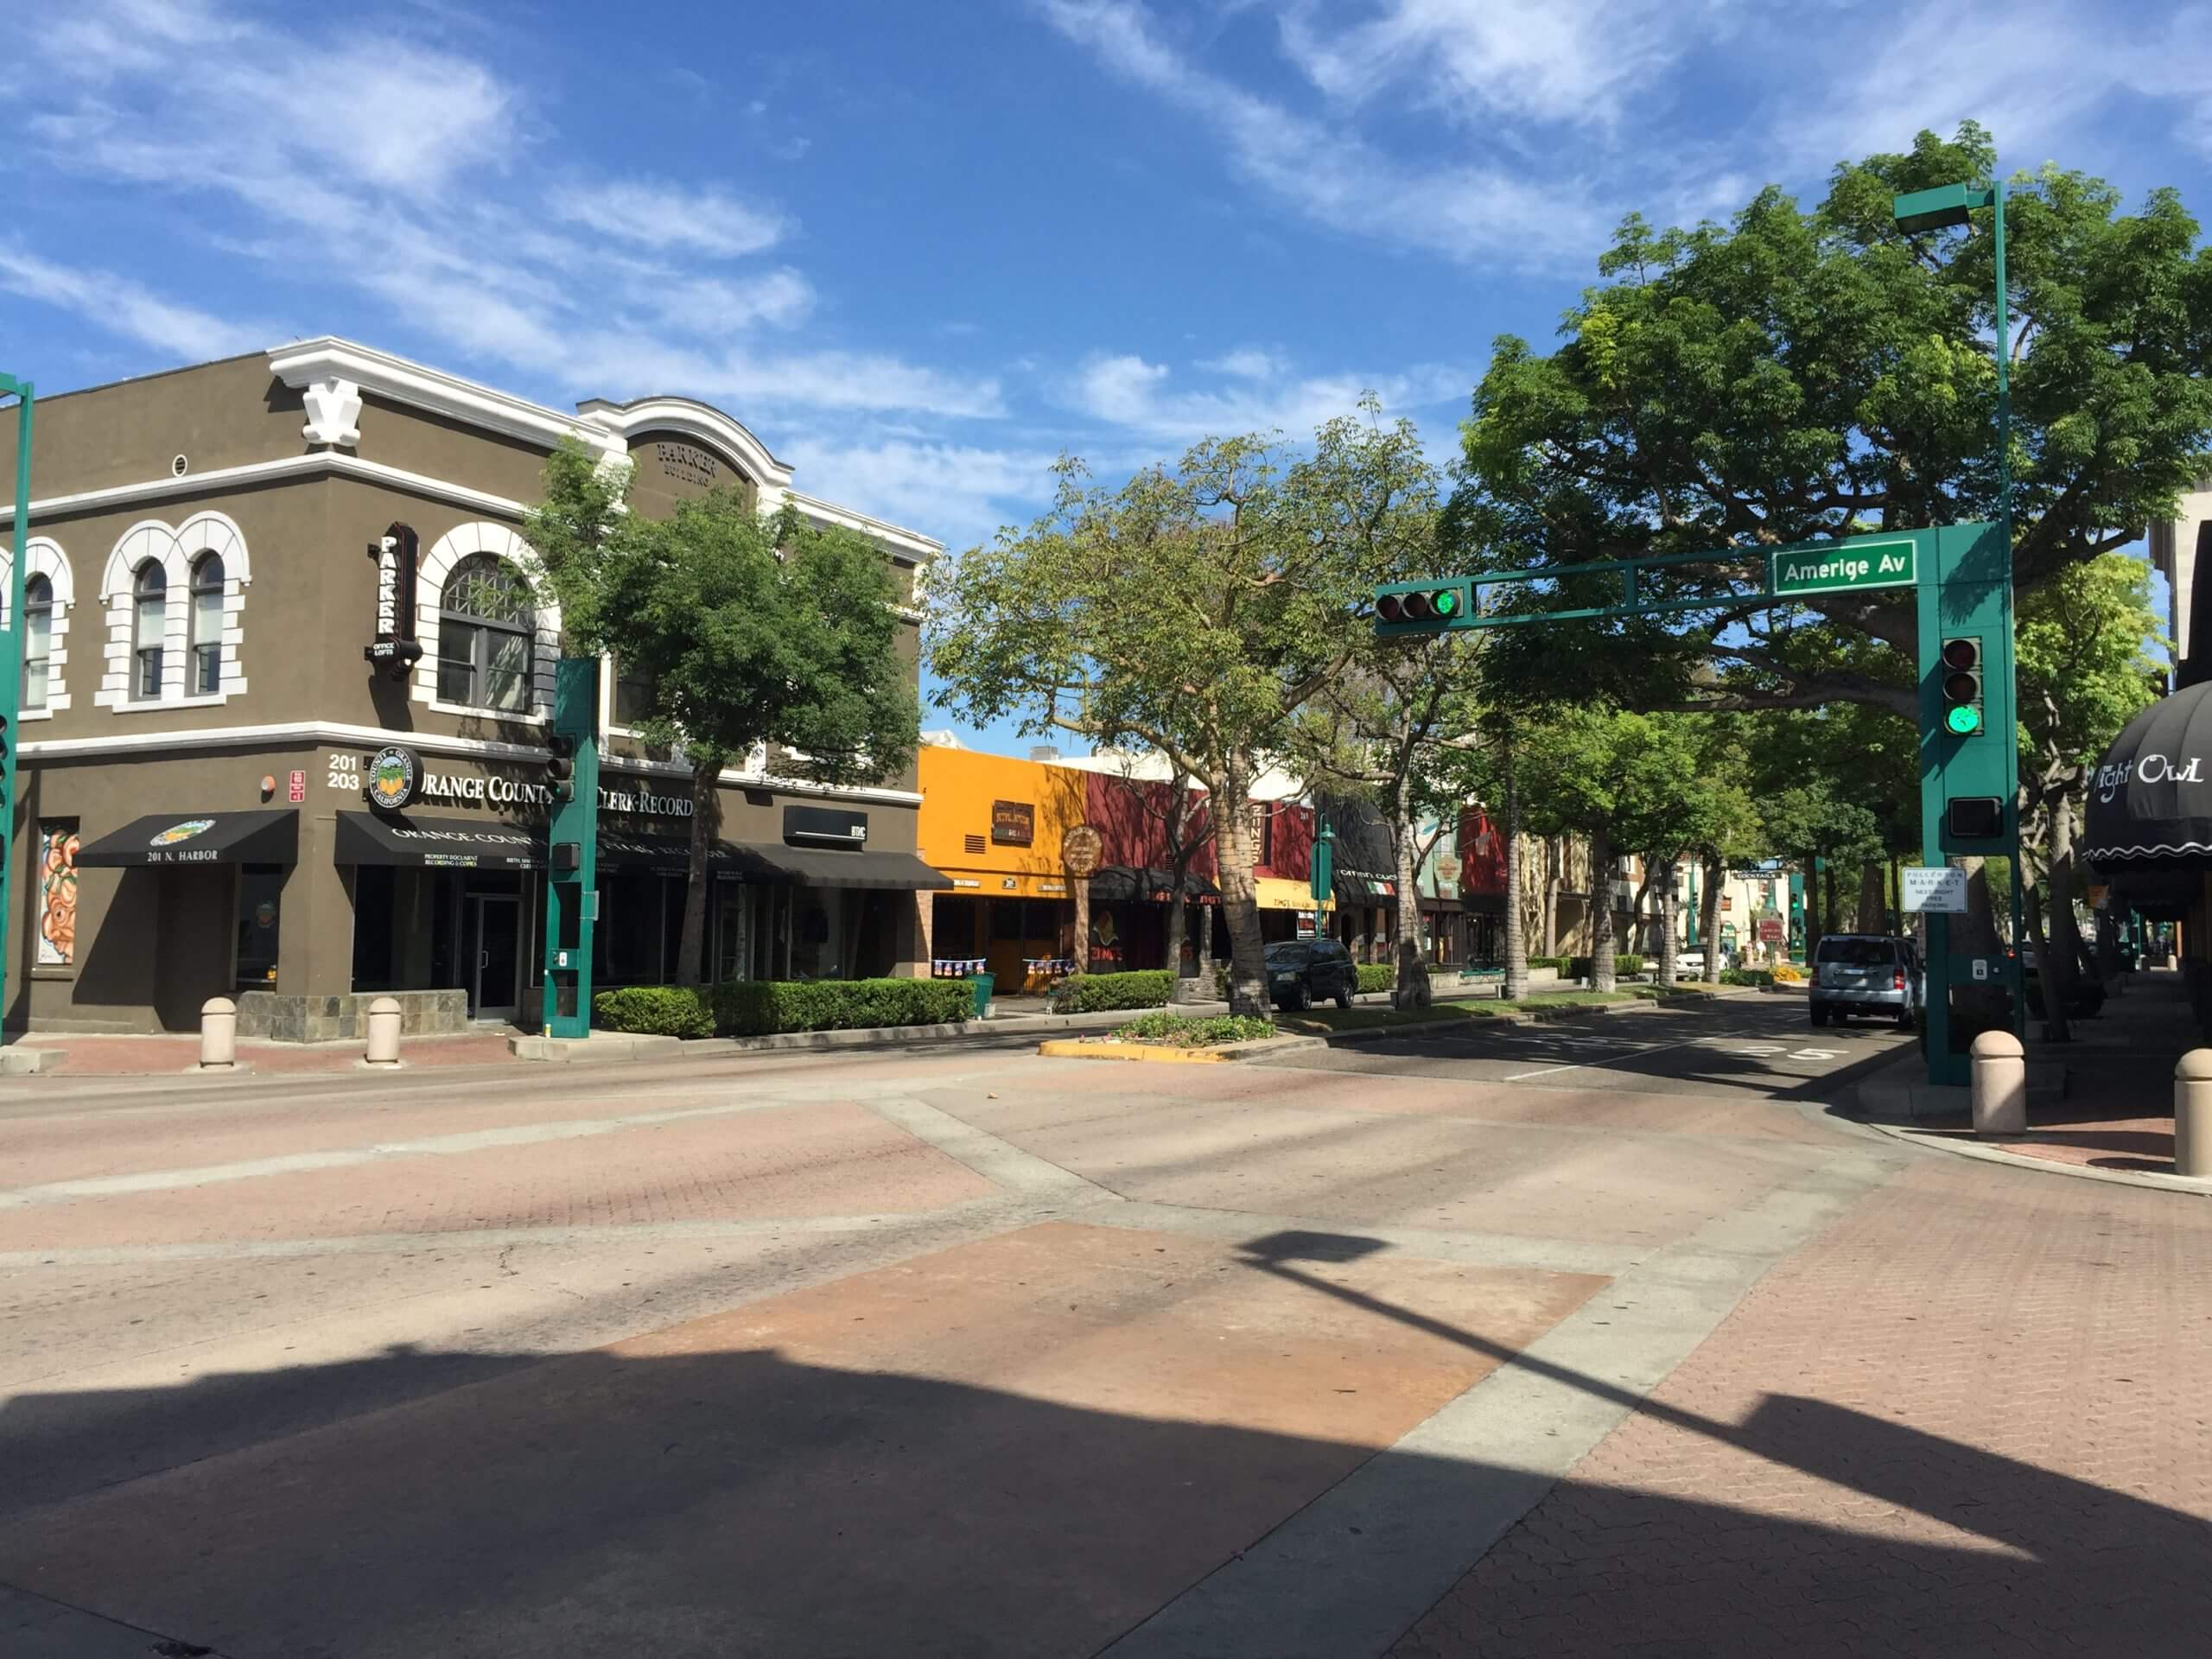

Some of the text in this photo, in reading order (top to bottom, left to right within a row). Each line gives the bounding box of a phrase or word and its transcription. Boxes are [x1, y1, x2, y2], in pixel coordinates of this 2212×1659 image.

[1784, 554, 1906, 582] Amerige Av
[378, 536, 397, 634] PARKER
[328, 753, 356, 771] 201
[327, 772, 359, 790] 203
[421, 772, 485, 799] RANGE
[391, 828, 475, 842] ORANGE
[147, 849, 218, 862] 201 N. HARBOR
